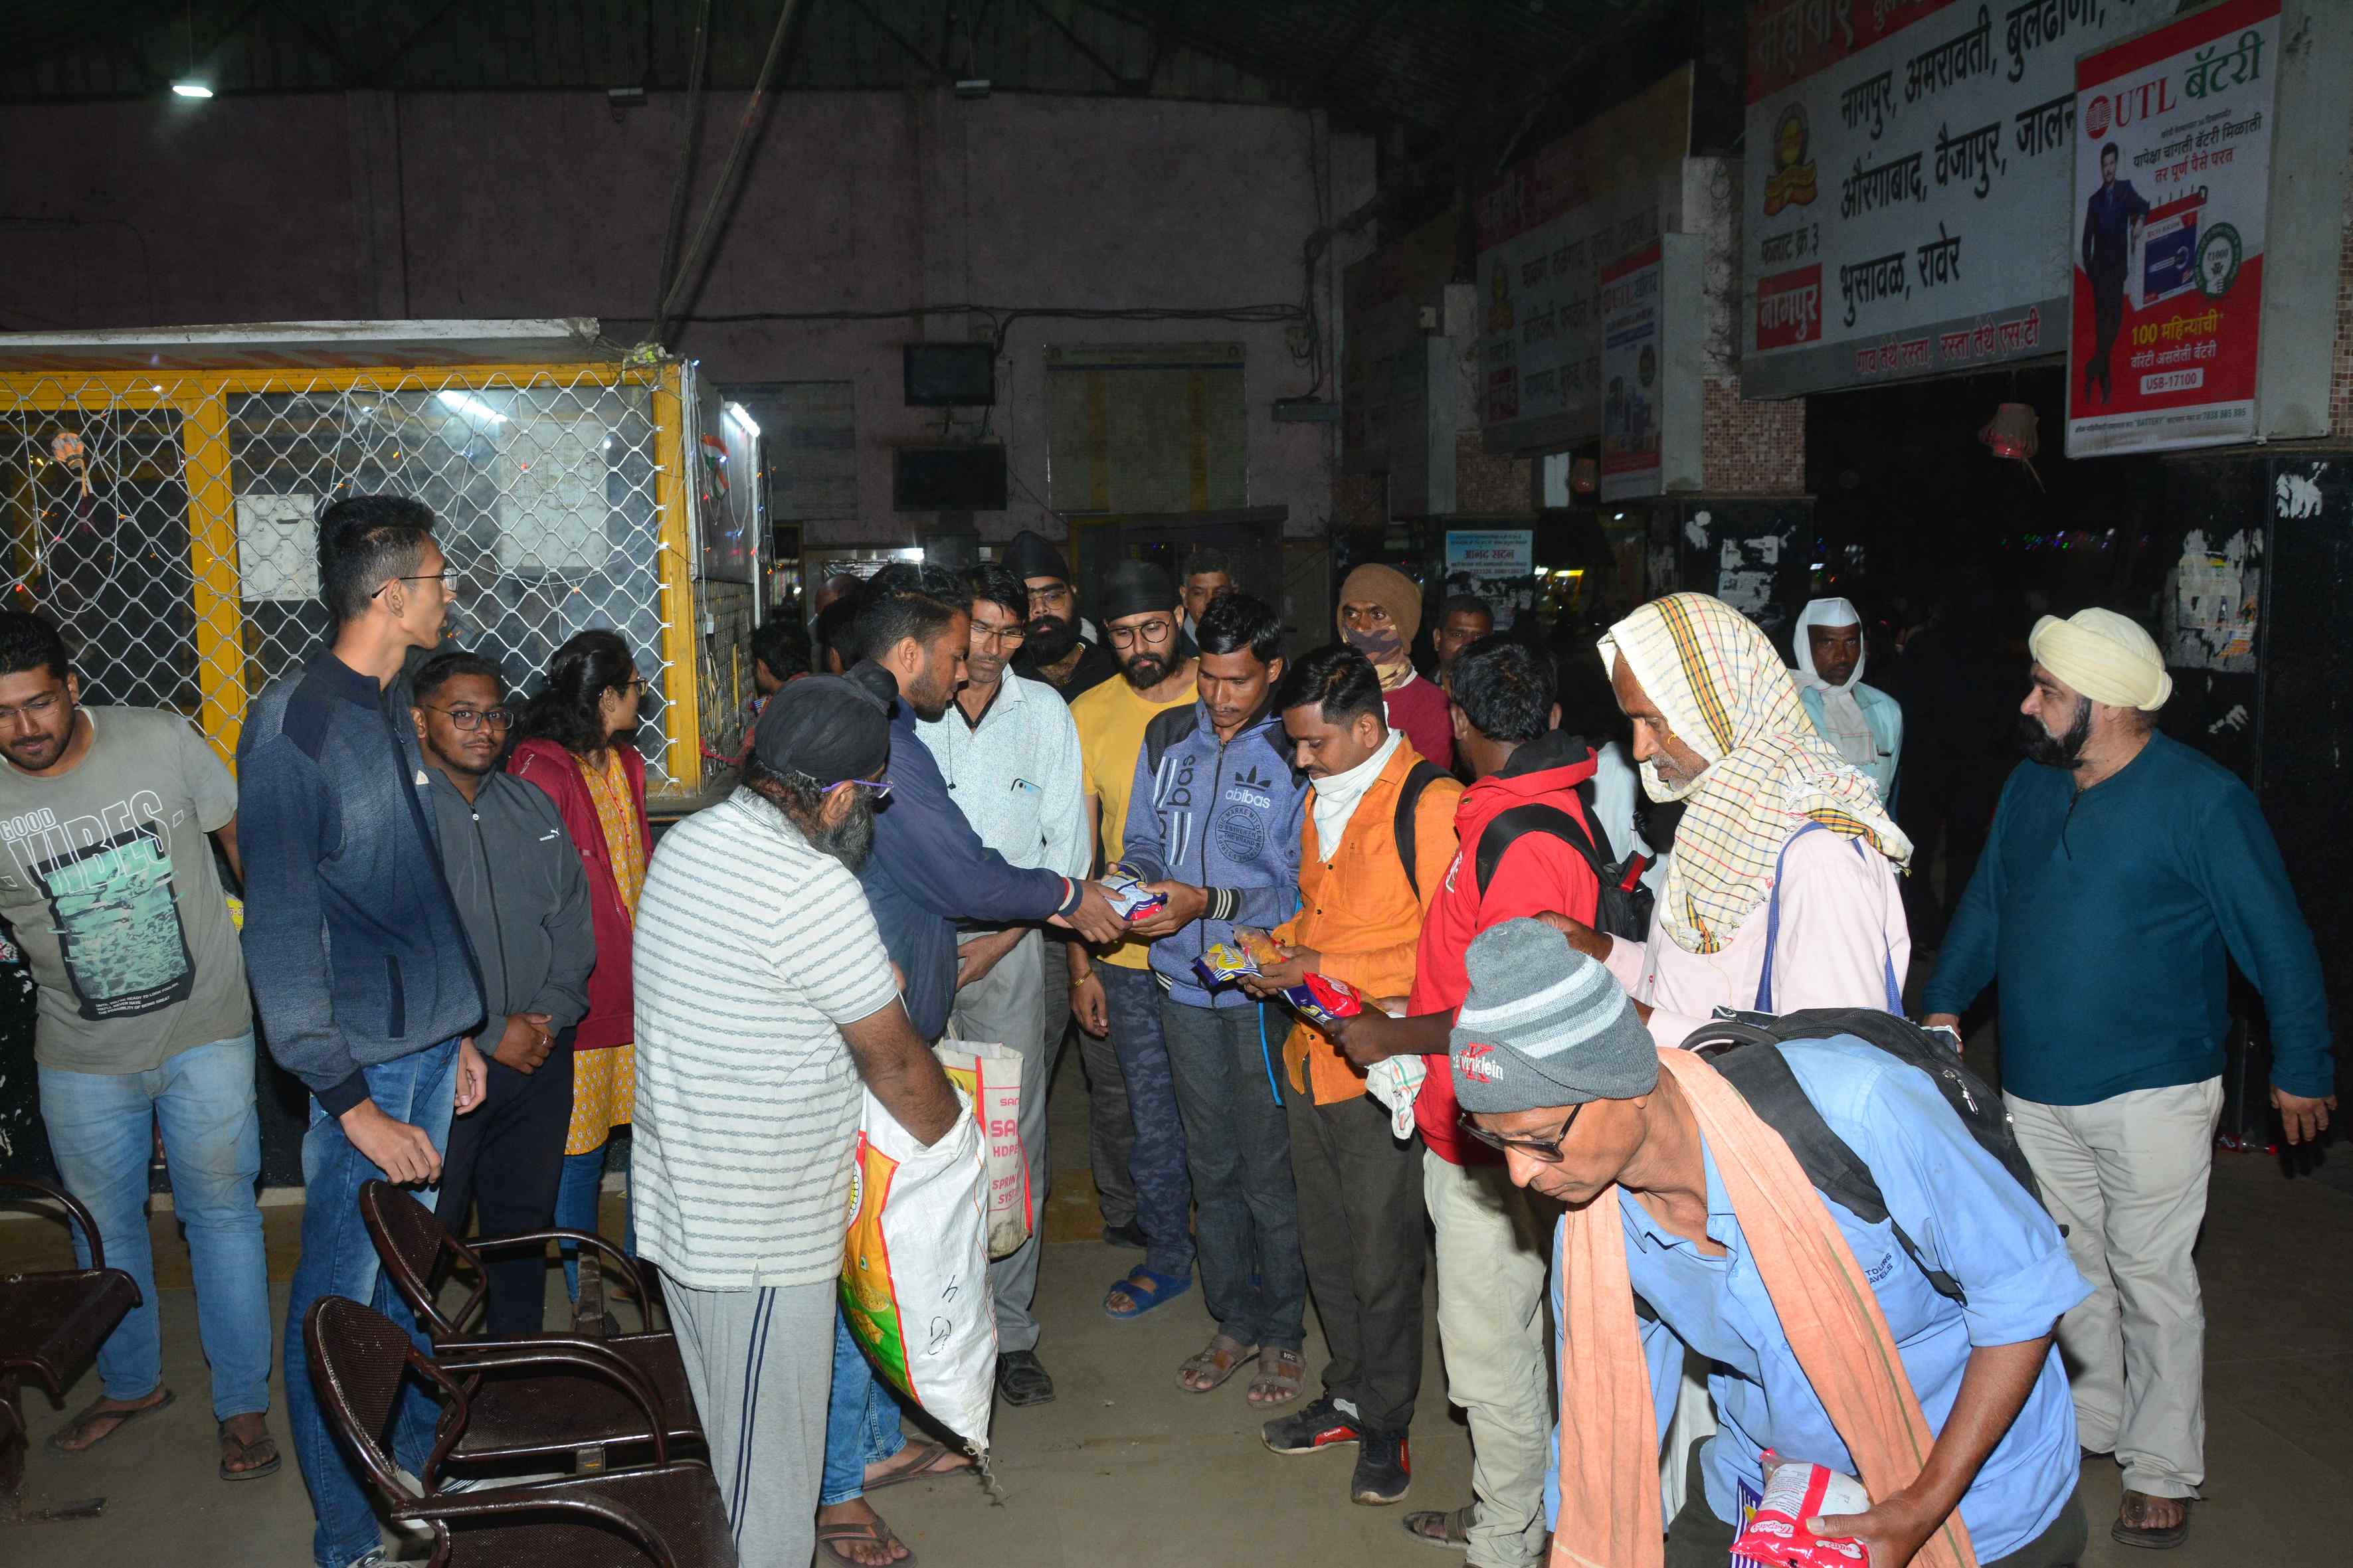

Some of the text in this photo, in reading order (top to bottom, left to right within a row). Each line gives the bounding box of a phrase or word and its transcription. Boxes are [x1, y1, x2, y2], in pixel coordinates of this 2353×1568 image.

[1841, 69, 1897, 139] नागपुर,
[1905, 4, 1996, 103] अमरावती,
[2115, 30, 2265, 128] UTL बॅटरी
[2221, 112, 2263, 141] मिळाली
[1841, 150, 1928, 220] औरंगाबाद,
[1935, 122, 2007, 199] वैजापुर,
[1839, 220, 1961, 327] भुसावळ, रावेर
[1760, 283, 1819, 341] नागपुर
[2130, 322, 2157, 346] 100
[2146, 373, 2198, 391] USB-17100
[0, 807, 56, 841] GOOD
[7, 790, 171, 900] VIBES
[990, 1119, 1019, 1138] SA
[1865, 1252, 1892, 1276] TOURS
